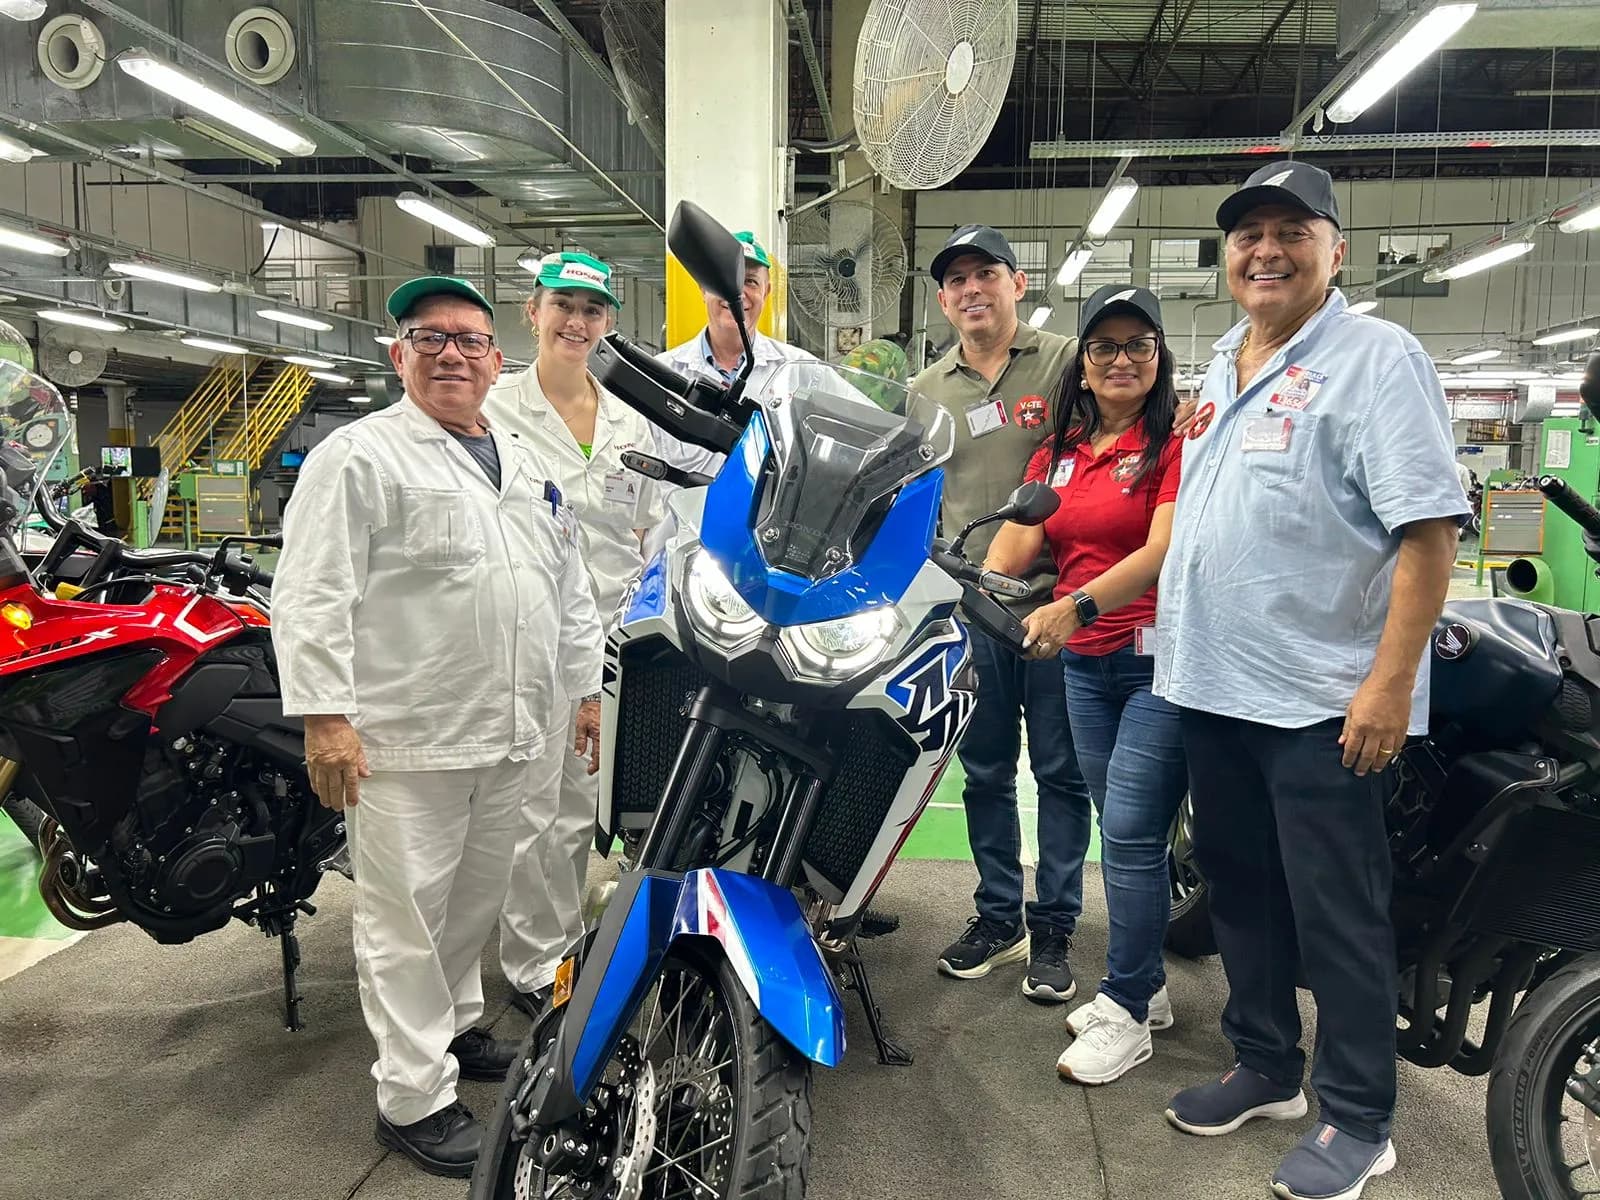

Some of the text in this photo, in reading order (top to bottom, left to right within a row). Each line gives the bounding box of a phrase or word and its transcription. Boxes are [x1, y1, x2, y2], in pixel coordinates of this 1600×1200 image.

[566, 269, 602, 284] HONDA
[1020, 400, 1042, 409] VOTE
[1514, 1072, 1528, 1149] MICHELIN
